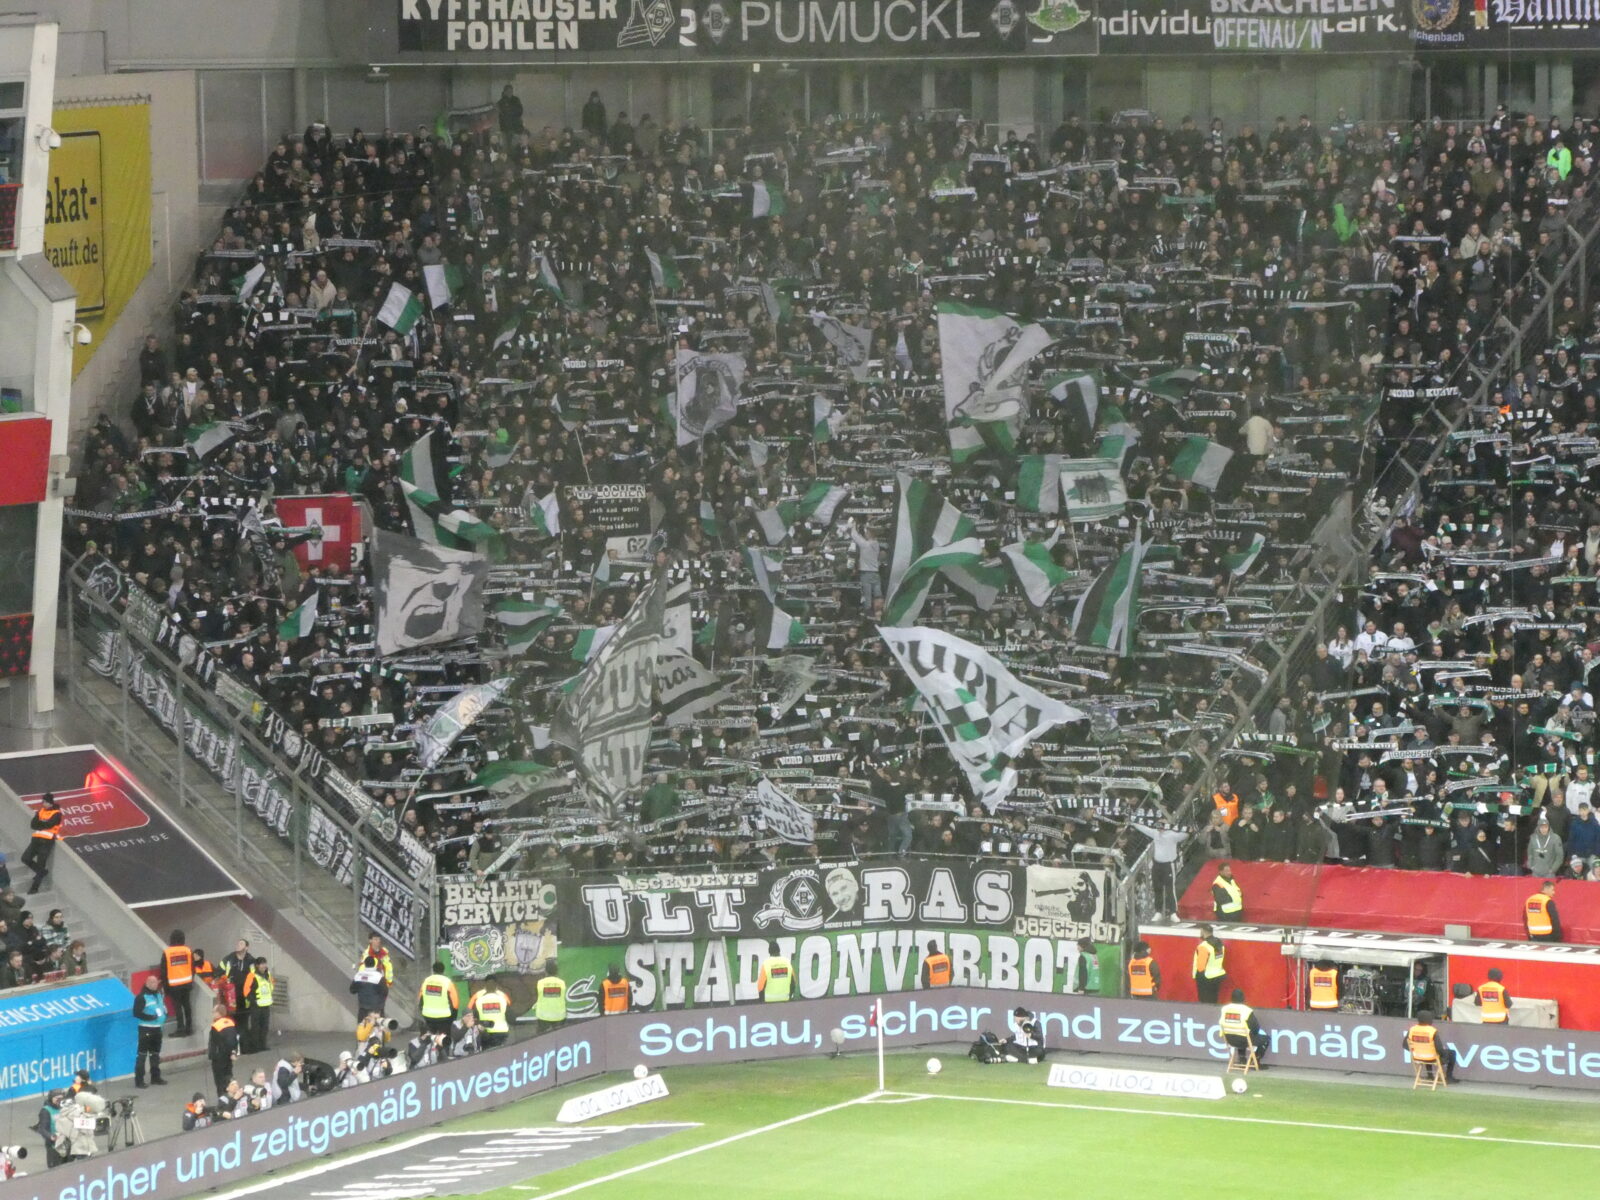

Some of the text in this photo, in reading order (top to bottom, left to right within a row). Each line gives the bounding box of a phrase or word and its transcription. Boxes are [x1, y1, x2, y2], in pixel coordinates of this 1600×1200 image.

[447, 21, 579, 51] FOHLEN
[741, 0, 981, 43] PUMUCKL
[444, 880, 541, 906] BEGLEIT
[444, 901, 540, 925] SERVICE
[582, 866, 1013, 939] ULT RAS
[639, 1015, 823, 1058] Schlau,
[840, 1003, 991, 1040] sicher
[1118, 1013, 1386, 1061] zeitgmäß
[59, 1165, 166, 1200] sicher
[176, 1131, 241, 1183] und
[251, 1079, 421, 1162] zeitgemäß
[430, 1038, 592, 1113] investieren
